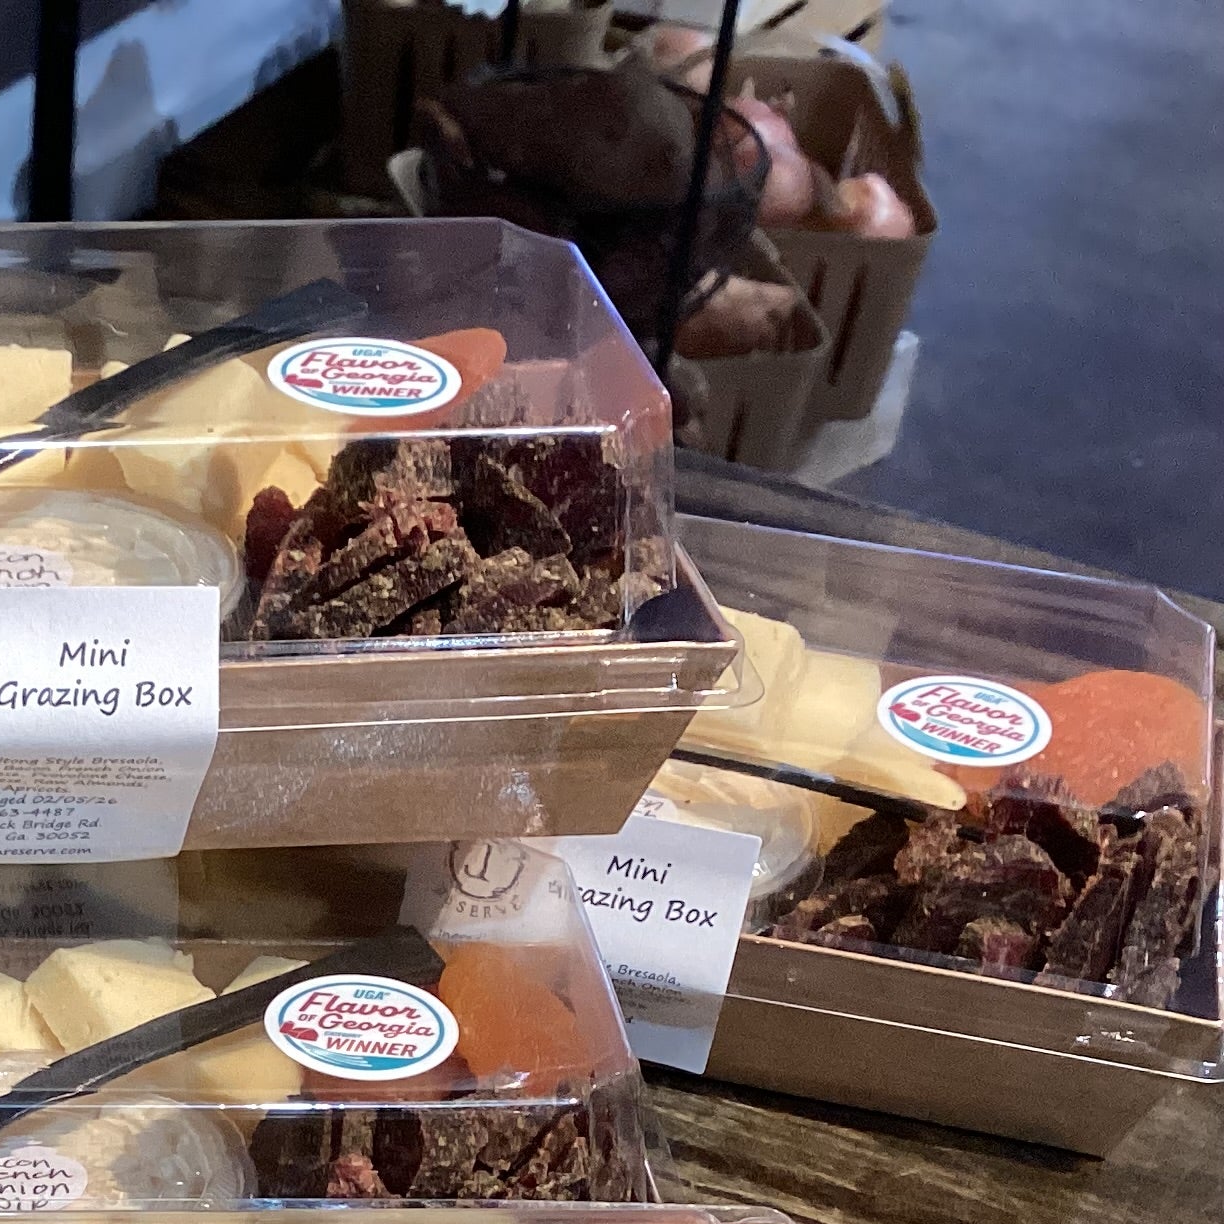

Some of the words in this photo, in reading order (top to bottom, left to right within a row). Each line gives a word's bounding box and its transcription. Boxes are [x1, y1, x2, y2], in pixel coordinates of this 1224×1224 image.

[300, 351, 421, 370] Flavor
[321, 367, 437, 385] Georgia
[332, 384, 422, 398] WINNER
[58, 638, 131, 668] Mini
[135, 681, 193, 708] Box
[917, 686, 1024, 726] Flavor
[926, 704, 1025, 742] Georgia
[920, 722, 1003, 754] WINNER
[46, 756, 85, 768] Style
[22, 819, 72, 831] Bridge
[35, 832, 91, 841] 30052
[606, 854, 673, 886] Mini
[663, 899, 719, 928] Box
[617, 964, 681, 987] Bresaola,
[299, 991, 421, 1020] Flavor
[297, 1013, 317, 1022] OF
[317, 1012, 435, 1039] Georgia
[326, 1036, 419, 1057] WINNER
